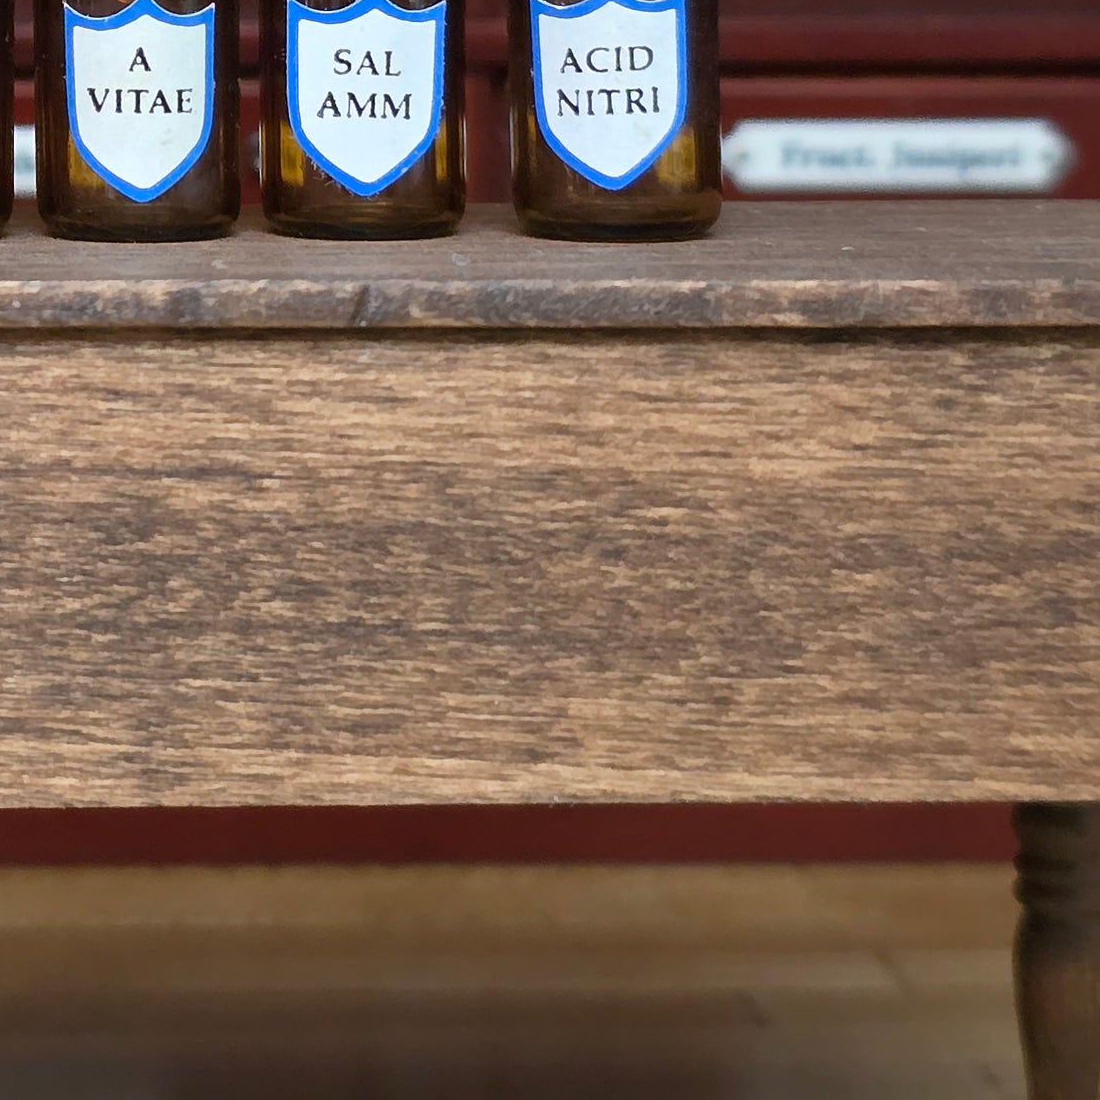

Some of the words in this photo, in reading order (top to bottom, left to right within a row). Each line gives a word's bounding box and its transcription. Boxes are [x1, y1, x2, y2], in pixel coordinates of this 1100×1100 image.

[128, 46, 153, 73] A
[332, 49, 402, 77] SAL
[560, 46, 655, 75] ACID
[86, 87, 194, 114] VITAE
[316, 90, 413, 121] AMM
[556, 86, 661, 117] NITRI
